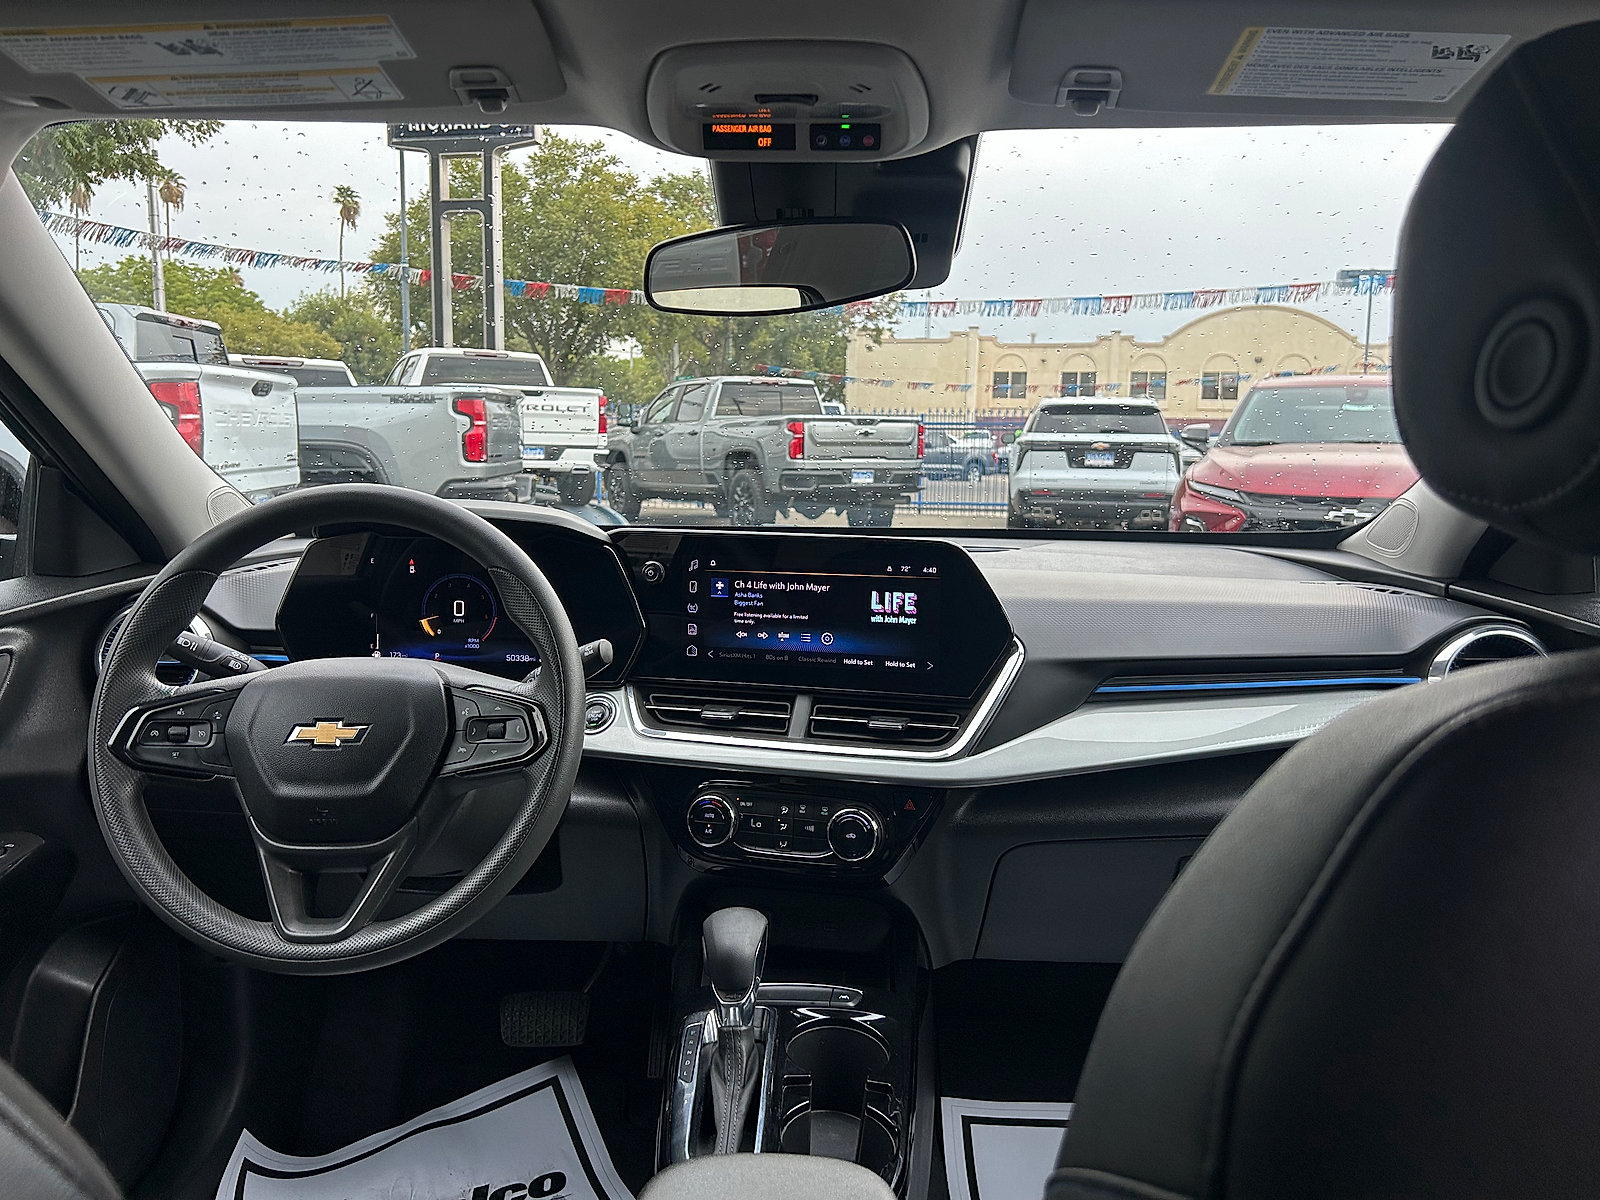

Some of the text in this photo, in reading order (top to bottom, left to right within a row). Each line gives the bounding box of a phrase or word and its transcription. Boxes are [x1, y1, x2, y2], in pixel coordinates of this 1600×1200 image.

[712, 125, 772, 133] PASSENGER AIR BAG
[758, 138, 772, 147] OFF
[734, 581, 745, 589] Ch
[754, 581, 767, 589] Life
[769, 582, 785, 590] with
[787, 582, 804, 592] John
[806, 583, 830, 593] Mayer
[871, 591, 917, 614] LIFE
[453, 600, 465, 617] 0
[871, 615, 917, 625] with John Mayer
[885, 660, 898, 668] Hold
[906, 661, 915, 669] Set
